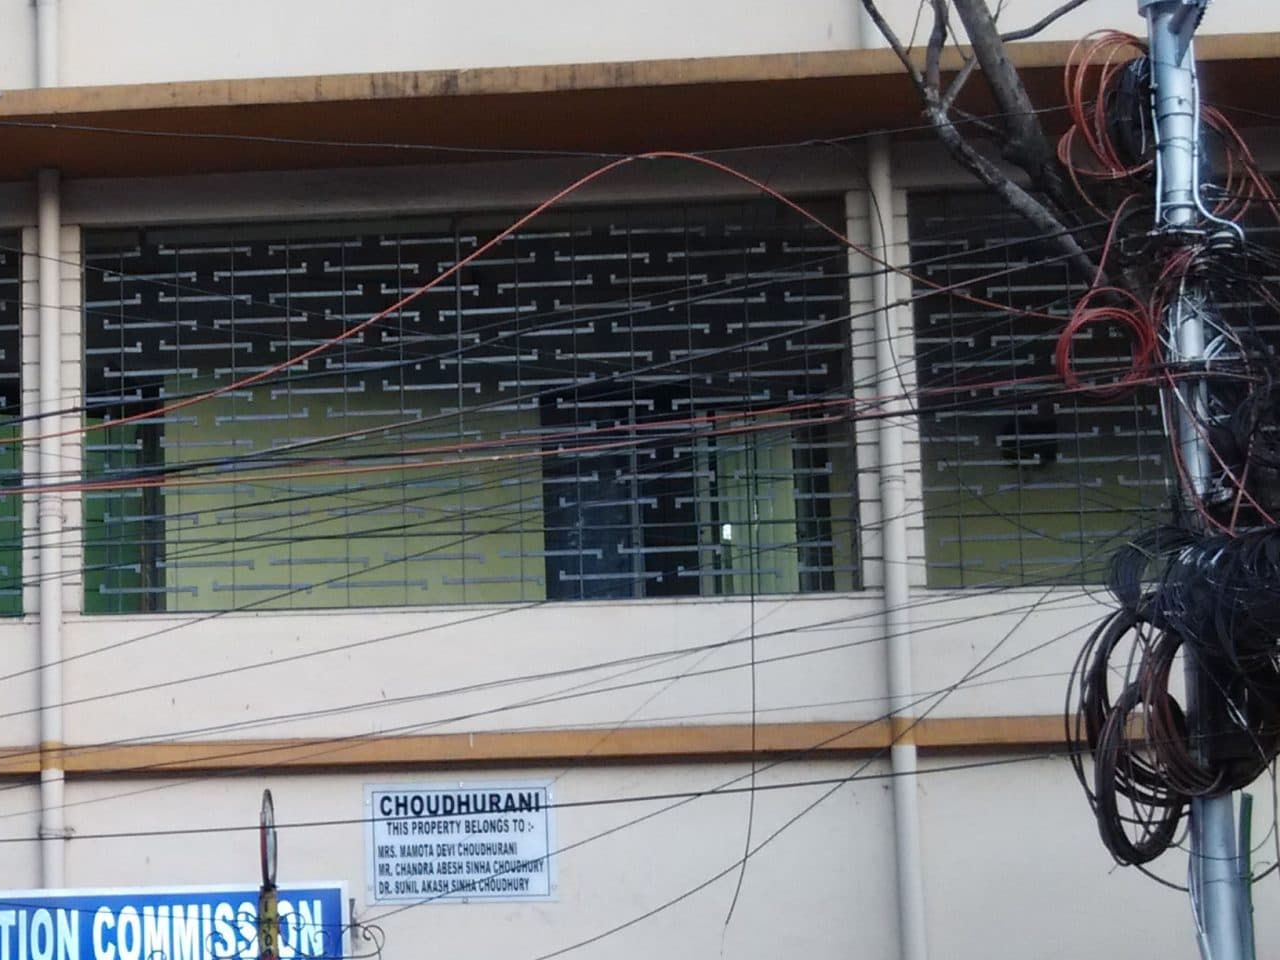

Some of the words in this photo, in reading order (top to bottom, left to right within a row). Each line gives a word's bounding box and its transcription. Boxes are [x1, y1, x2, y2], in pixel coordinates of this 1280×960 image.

[379, 792, 540, 817] CHOUDHURANI
[387, 821, 408, 836] THIS
[411, 820, 462, 835] PROPERTY
[464, 819, 510, 834] BELONGS
[512, 819, 525, 833] TO
[377, 845, 397, 858] MRS.
[436, 843, 456, 857] DEVI
[457, 842, 518, 856] CHOUDHURANI
[378, 863, 393, 876] MR.
[395, 862, 434, 876] CHANDRA
[436, 861, 463, 875] ABESH
[465, 861, 491, 874] SINHA
[493, 859, 544, 874] CHOUDHURY
[378, 881, 393, 895] DR.
[395, 881, 419, 894] SUNIL
[421, 880, 449, 893] AKASH
[451, 879, 477, 892] SINHA
[479, 878, 530, 892] CHOUDHURY
